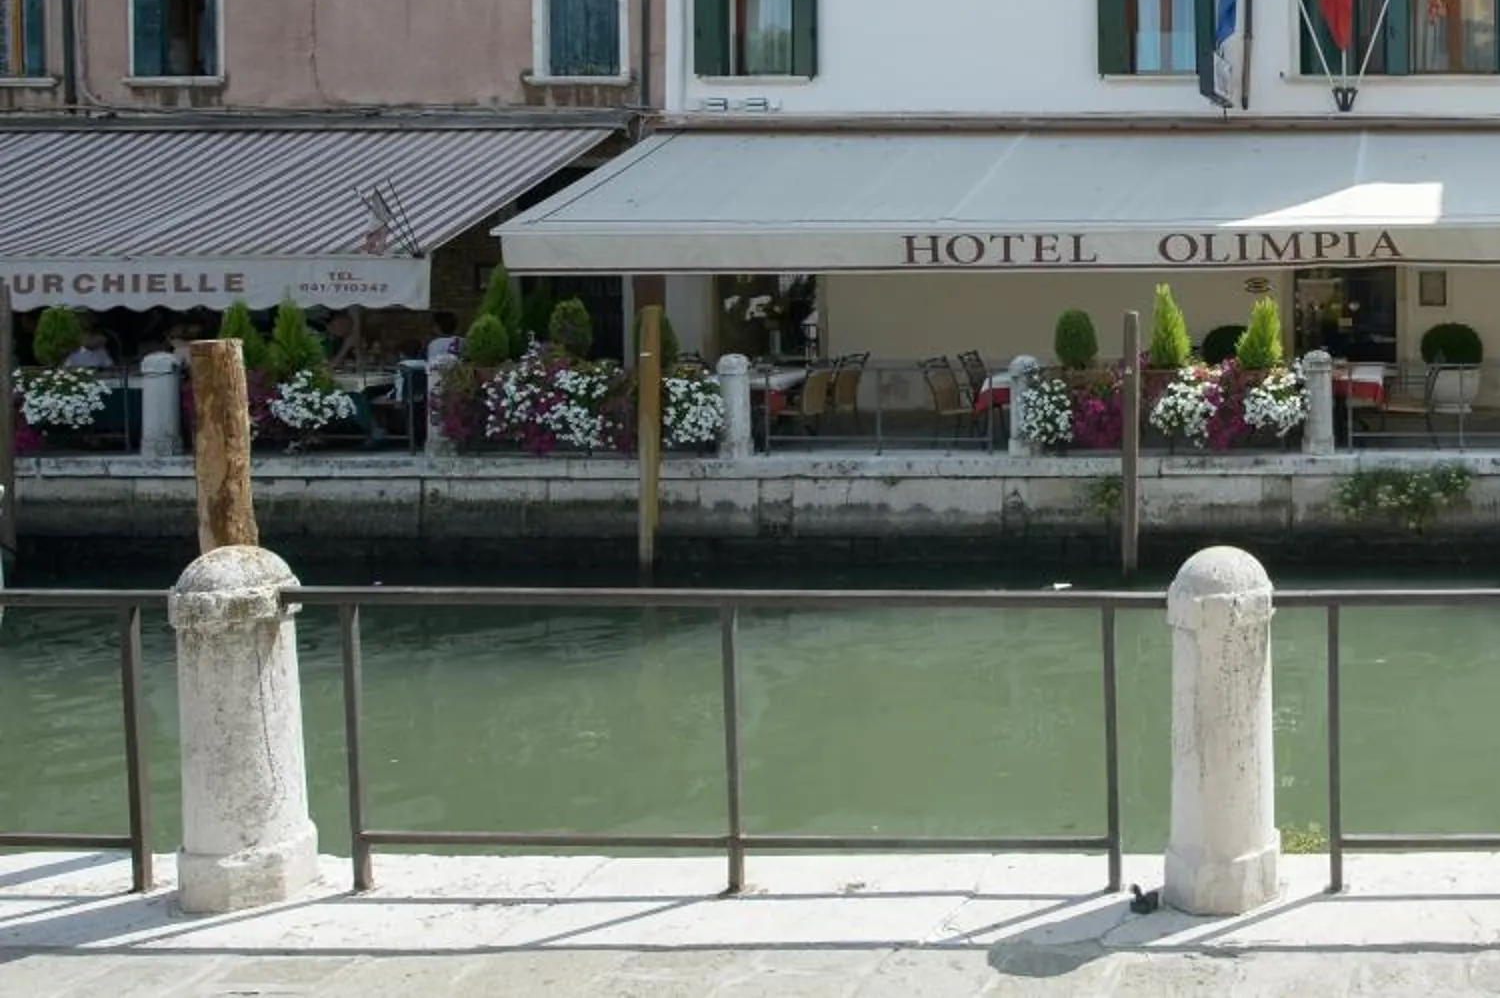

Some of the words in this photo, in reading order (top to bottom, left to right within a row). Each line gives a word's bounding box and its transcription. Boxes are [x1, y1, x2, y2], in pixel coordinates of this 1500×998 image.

[900, 234, 1098, 264] HOTEL
[1157, 230, 1405, 263] OLIMPIA
[0, 273, 246, 294] URCHIELLE
